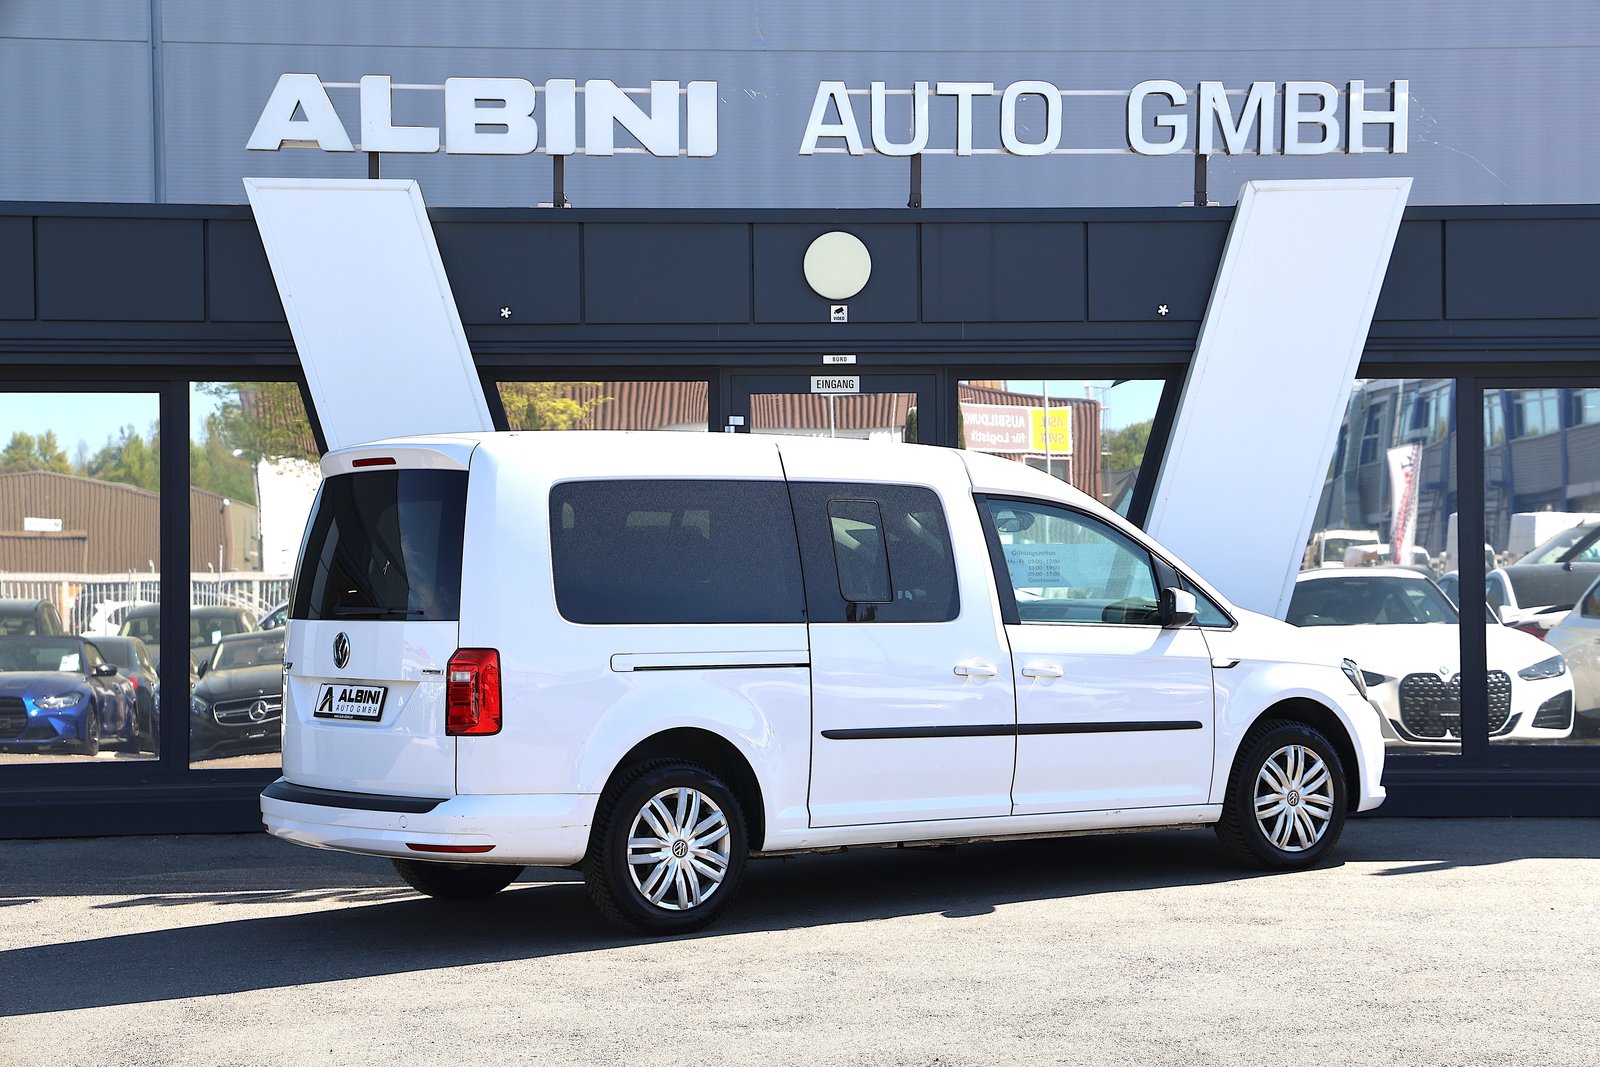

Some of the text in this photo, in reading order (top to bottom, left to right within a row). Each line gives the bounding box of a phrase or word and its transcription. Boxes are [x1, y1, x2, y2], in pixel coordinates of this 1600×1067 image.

[246, 73, 1409, 158] ALBINI AUTO GMBH
[816, 379, 855, 389] EINGANG
[338, 688, 381, 704] ALBINI
[336, 704, 378, 714] AUTO GMBH
